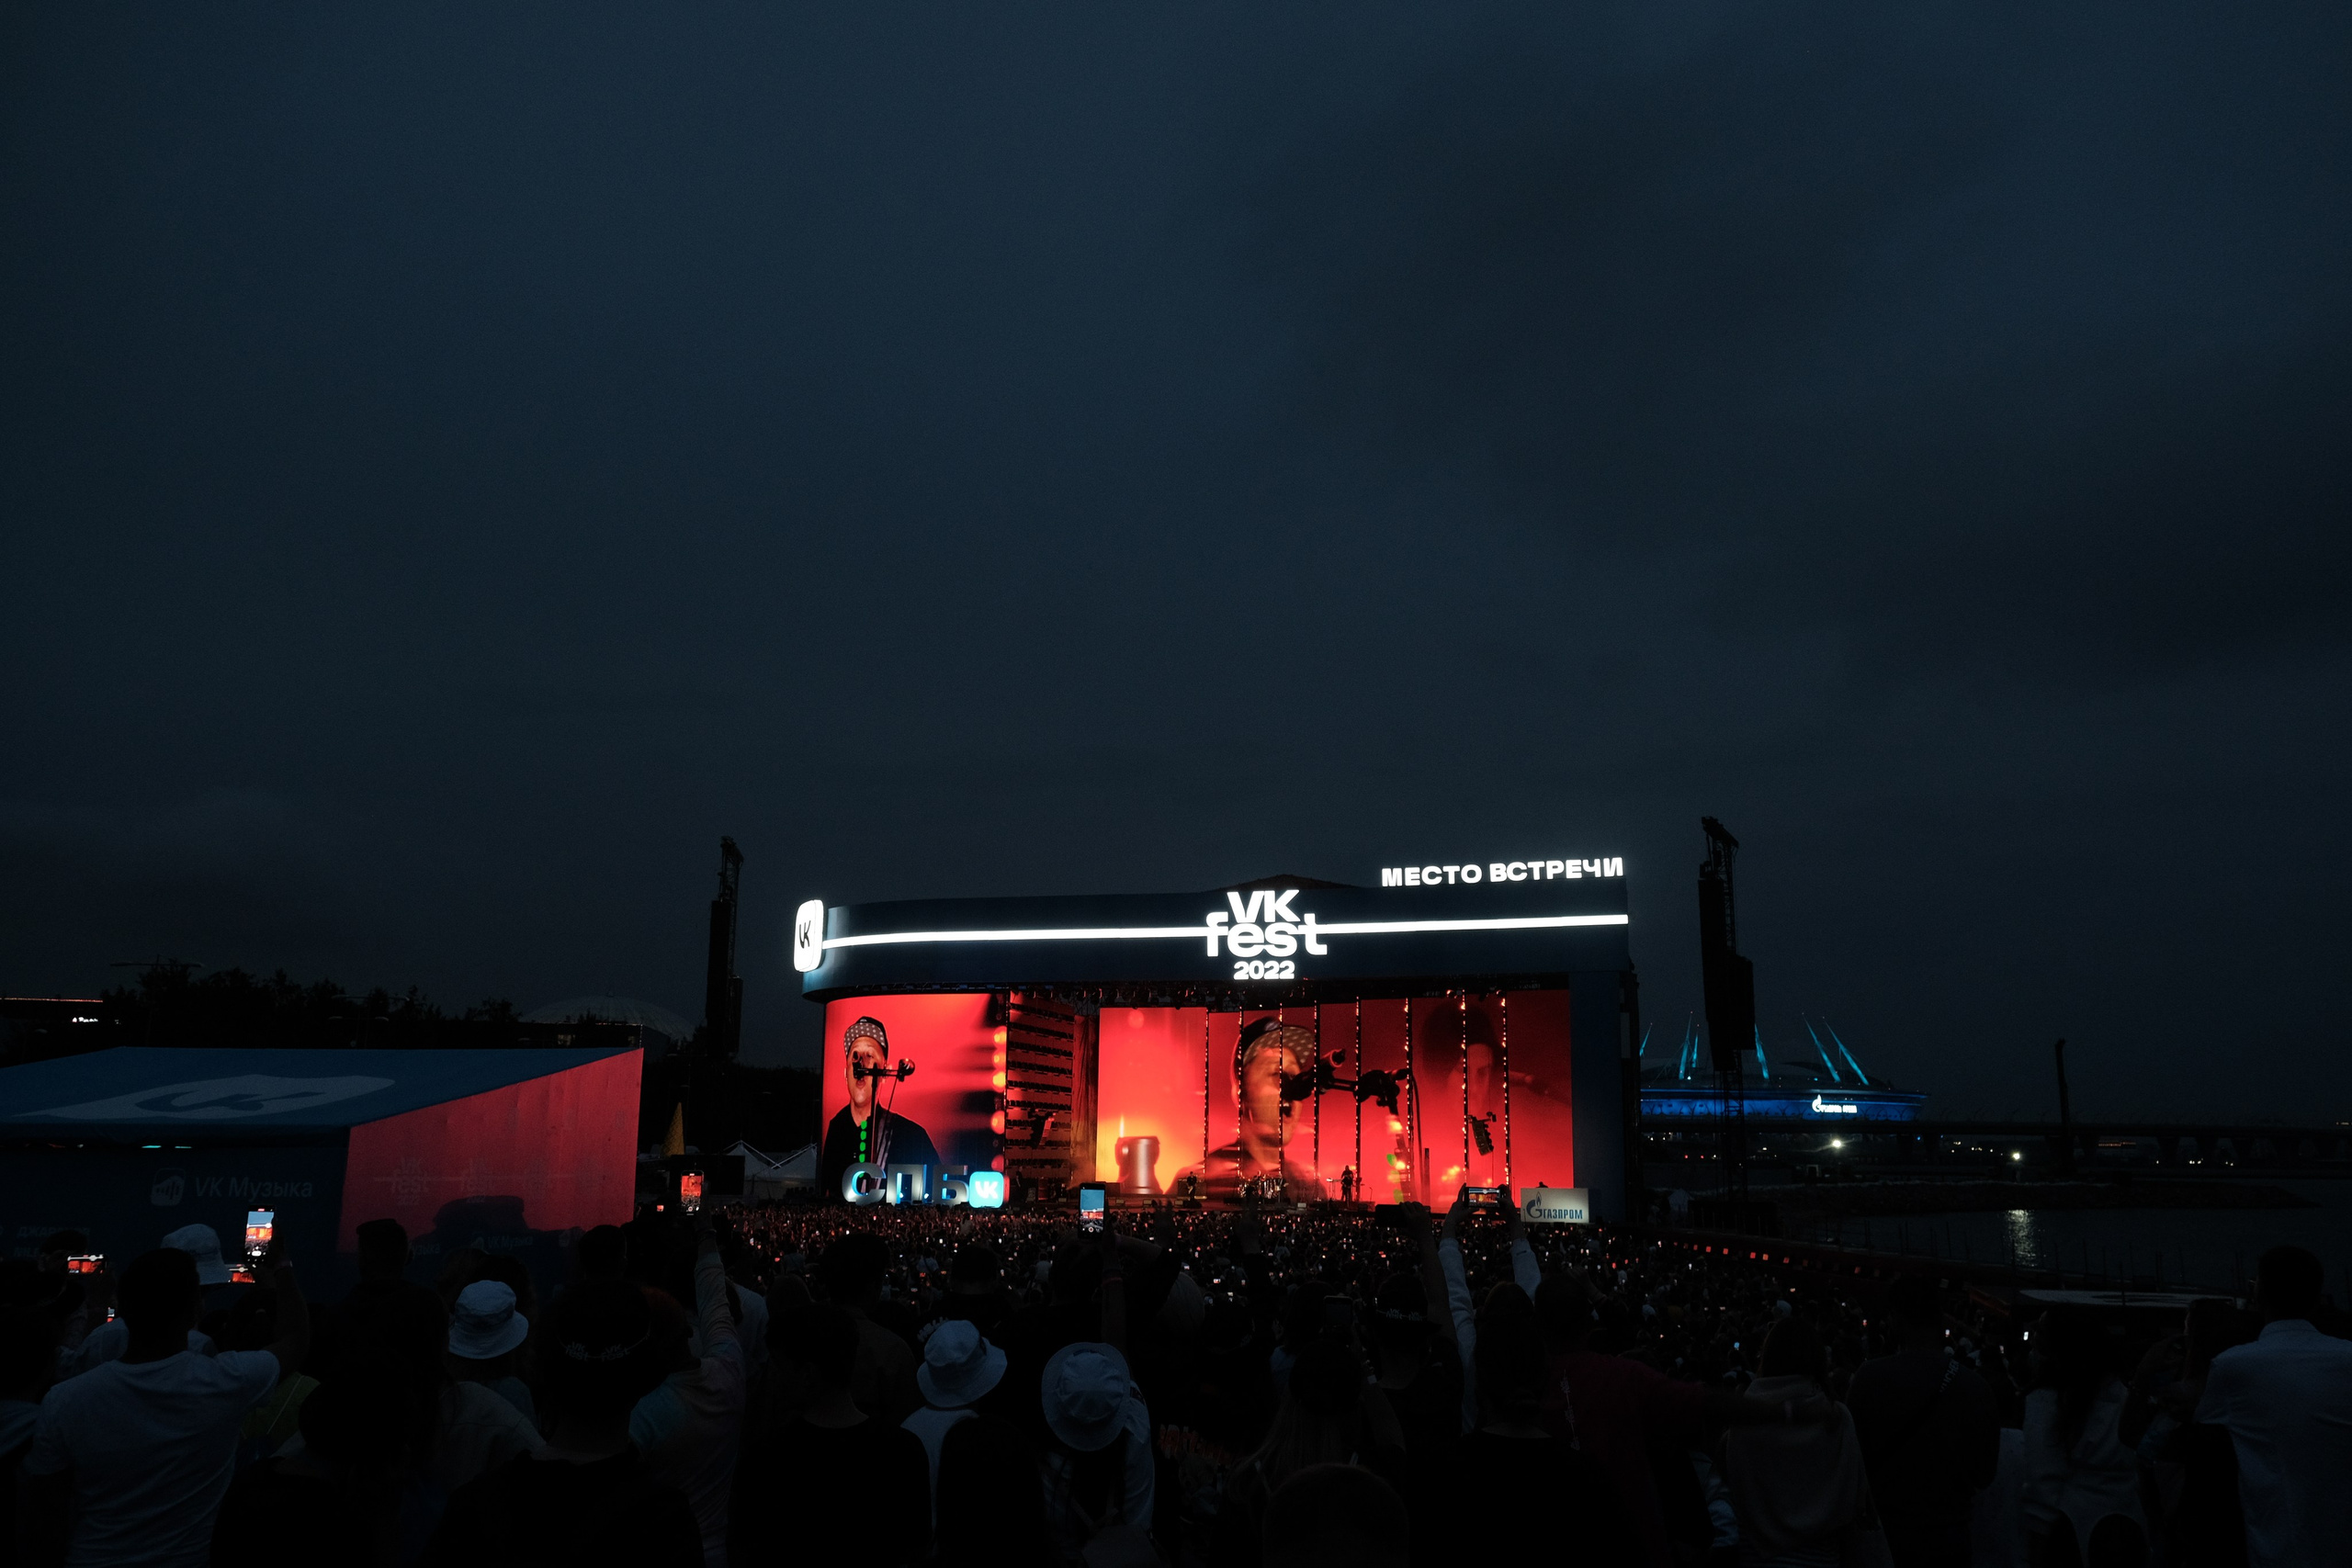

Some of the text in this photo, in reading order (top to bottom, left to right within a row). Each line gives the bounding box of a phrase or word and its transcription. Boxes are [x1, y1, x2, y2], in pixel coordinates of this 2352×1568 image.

[1381, 856, 1624, 887] МЕСТО ВСТРЕЧИ
[1227, 889, 1301, 923] VK
[1205, 911, 1328, 958] fest
[1233, 960, 1295, 980] 2022
[195, 1177, 313, 1202] VK Музыка
[842, 1162, 971, 1207] СПБ
[974, 1180, 1000, 1200] VK
[1544, 1208, 1583, 1220] ГАЗПРОМ
